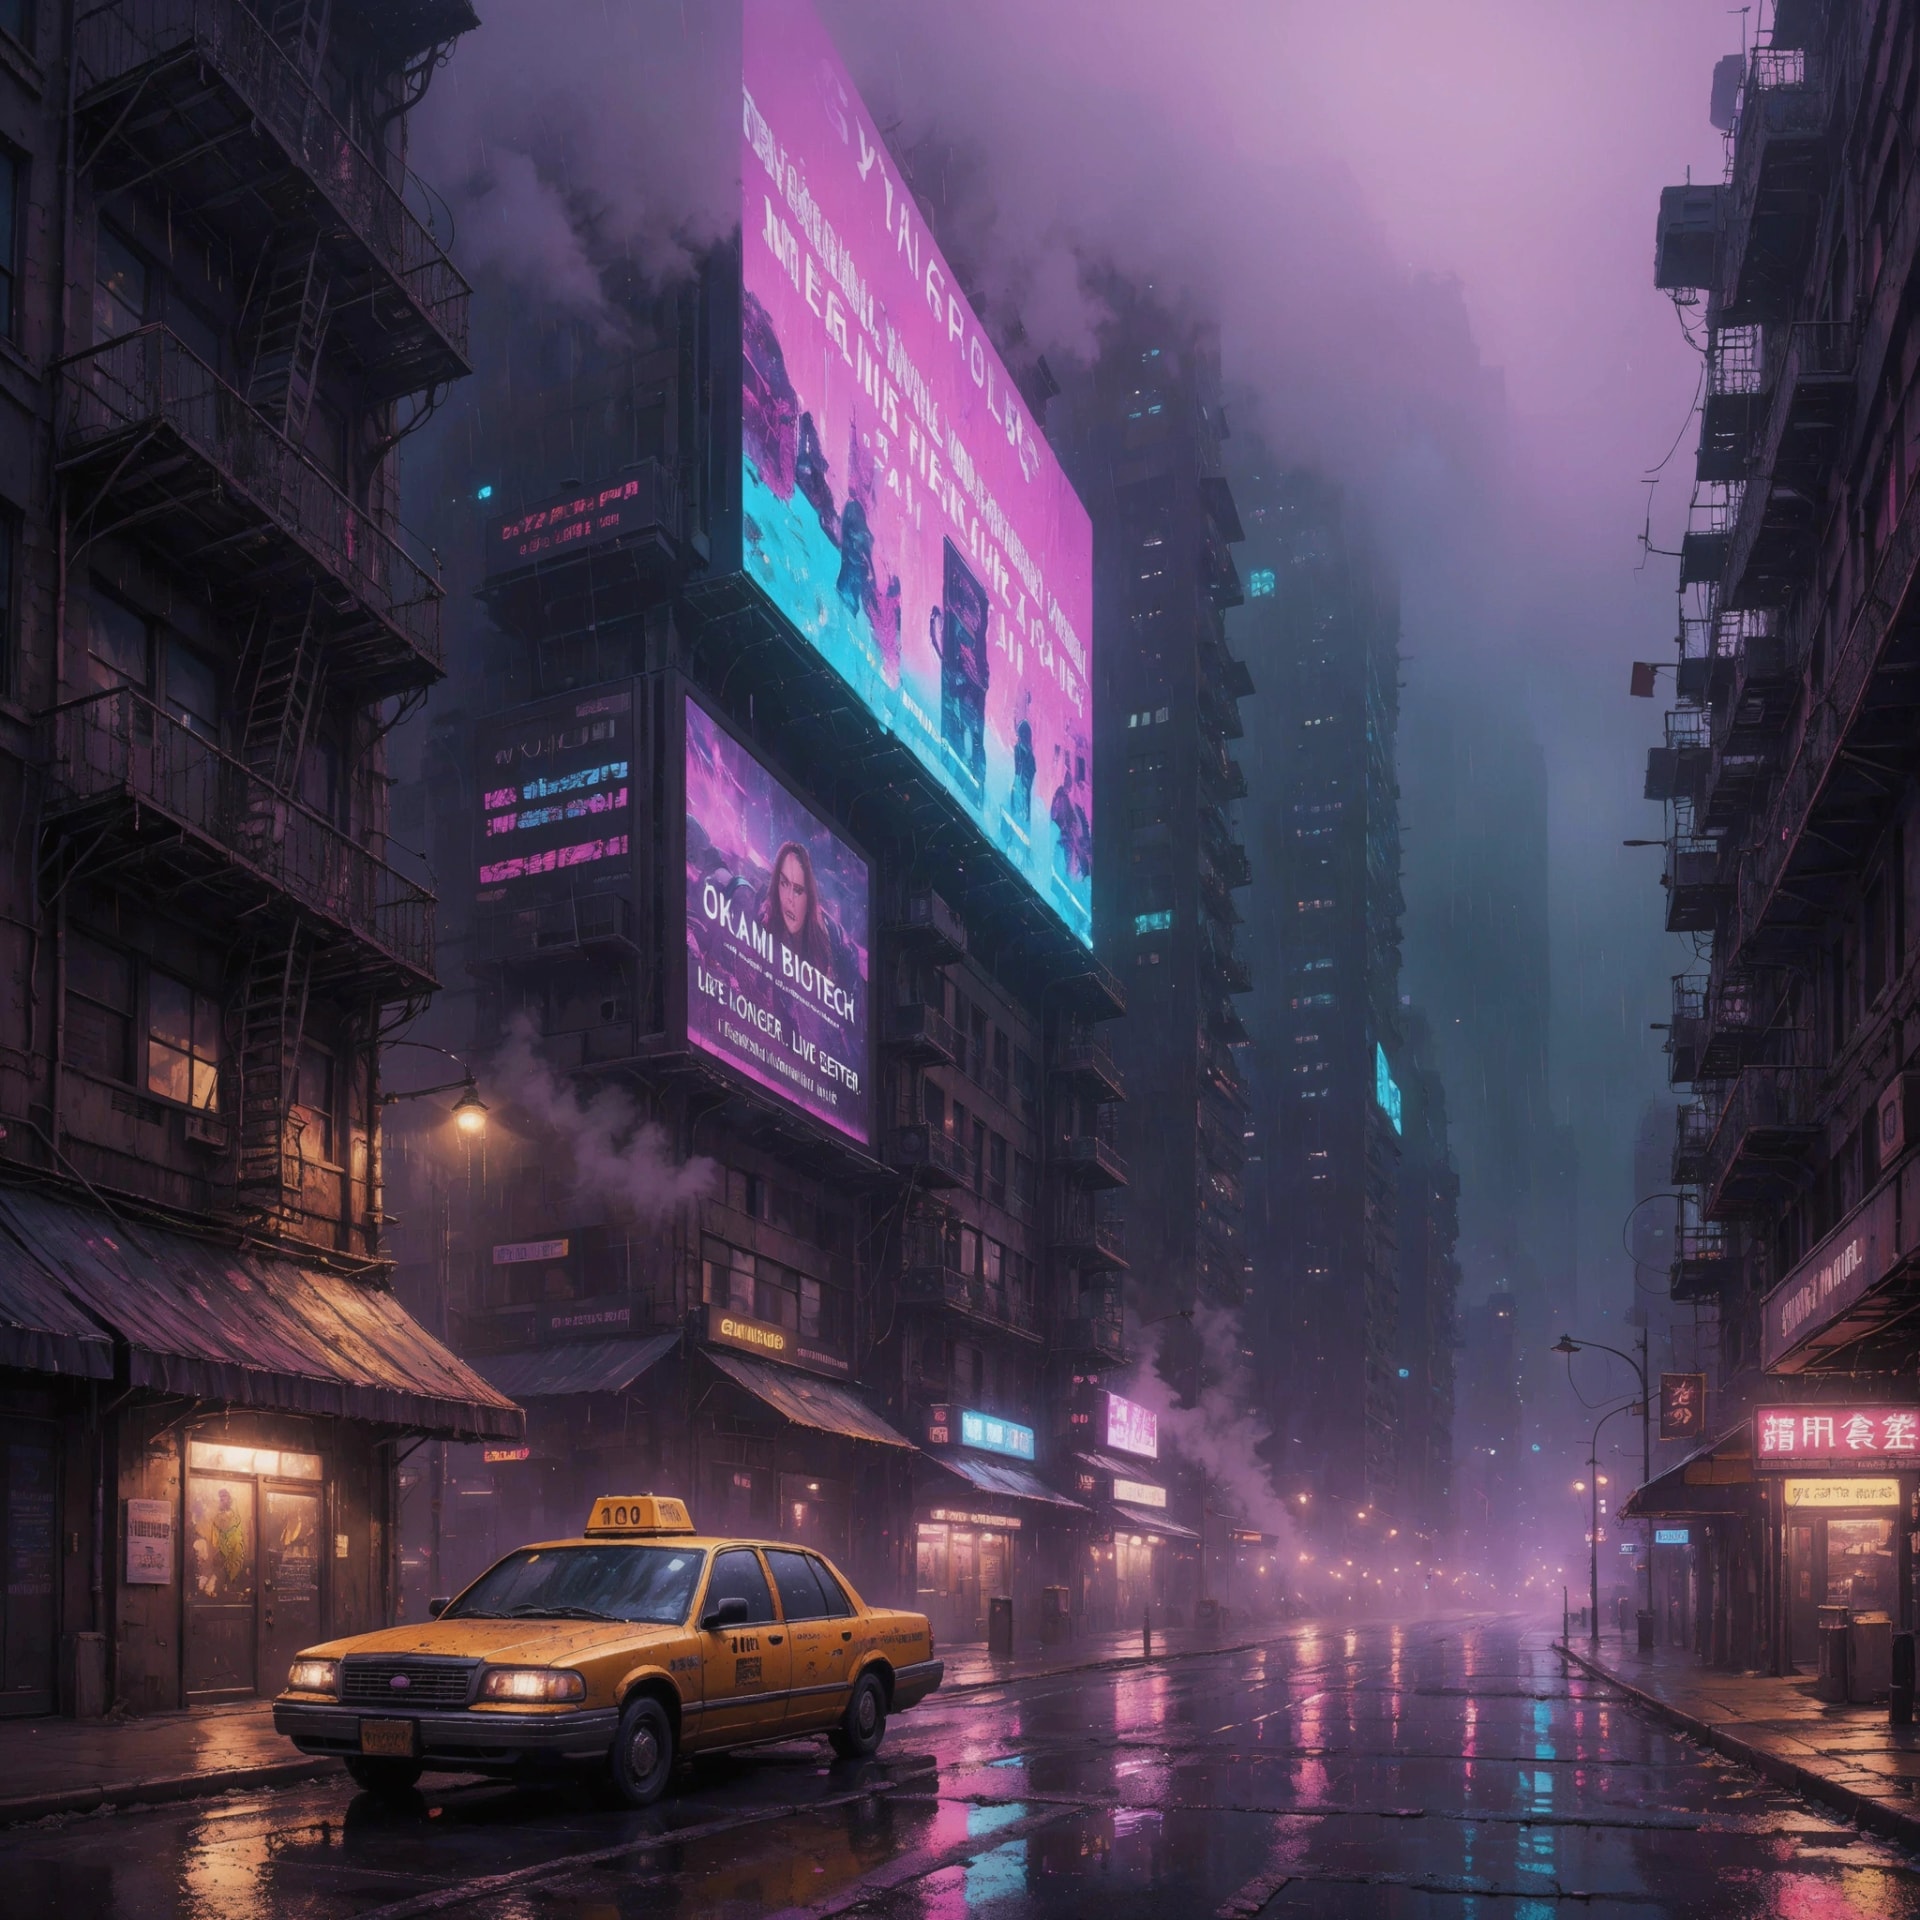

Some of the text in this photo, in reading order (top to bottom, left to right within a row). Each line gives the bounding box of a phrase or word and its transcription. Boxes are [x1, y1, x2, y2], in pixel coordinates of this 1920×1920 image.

[703, 881, 773, 964] OKAMI
[781, 942, 855, 1024] BIOTECH
[792, 1030, 816, 1065] LIVE
[601, 1506, 640, 1525] 100
